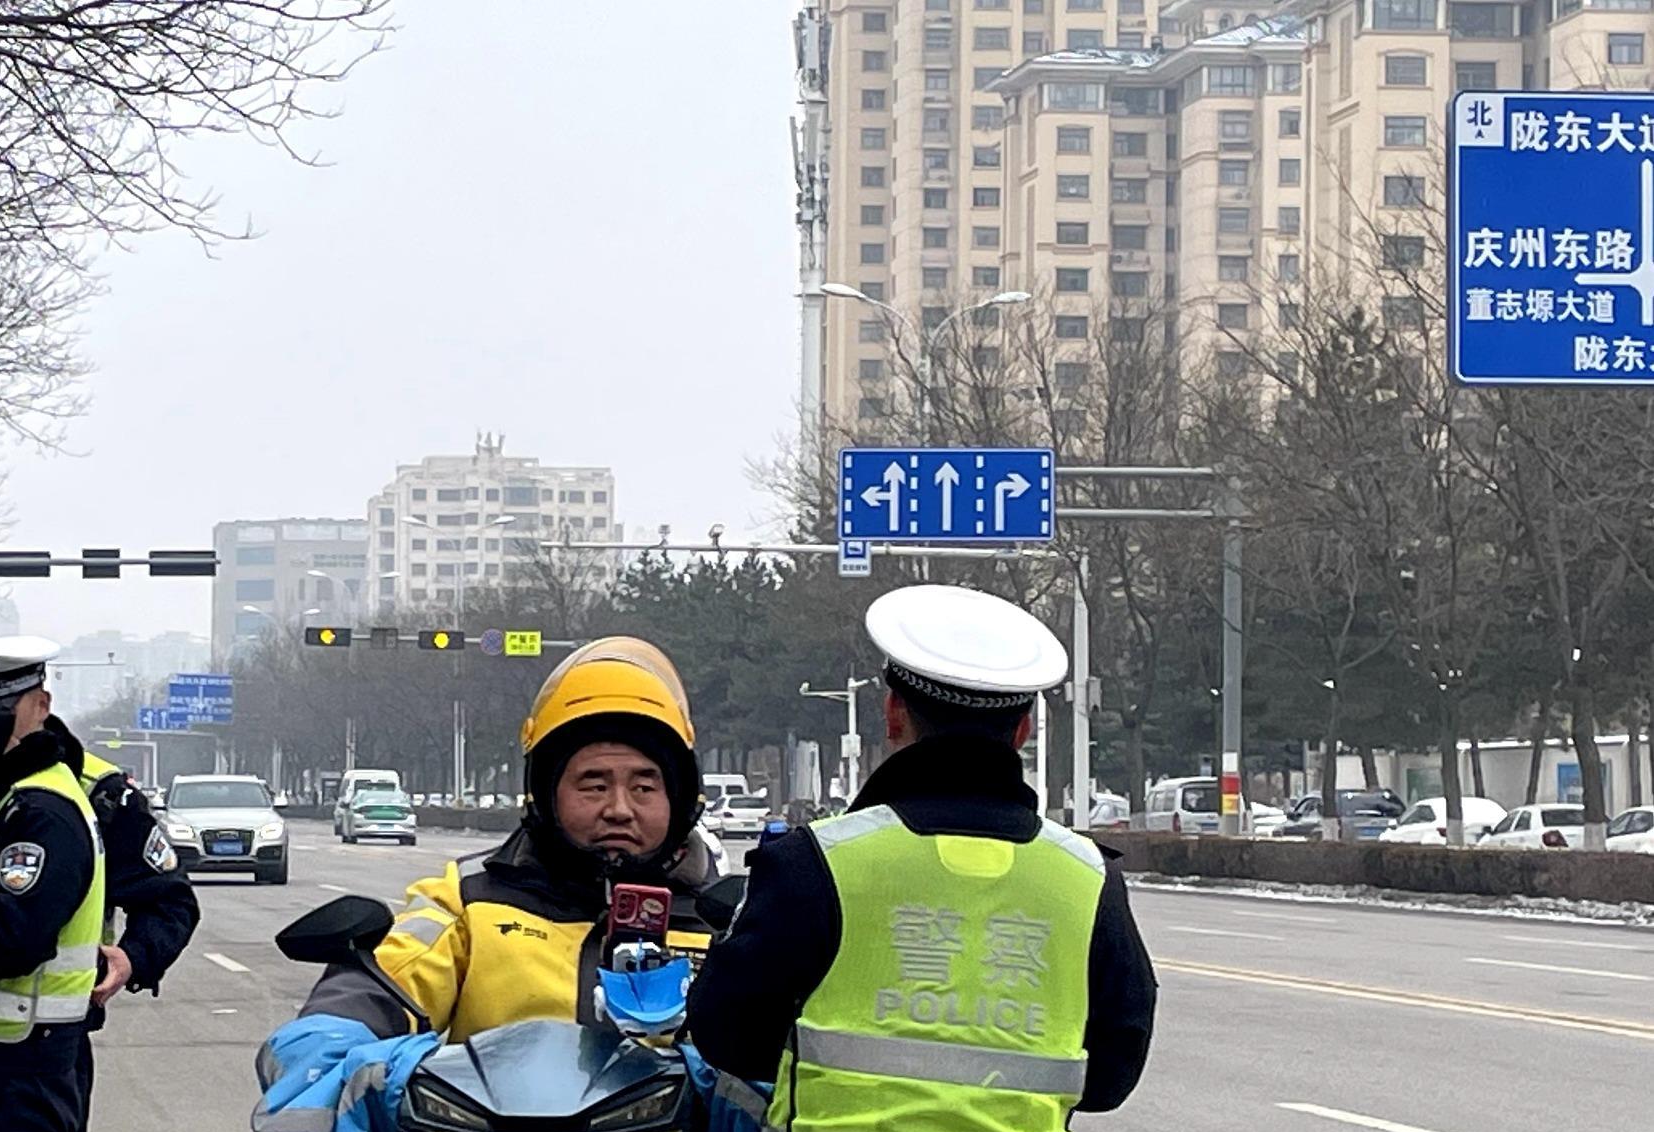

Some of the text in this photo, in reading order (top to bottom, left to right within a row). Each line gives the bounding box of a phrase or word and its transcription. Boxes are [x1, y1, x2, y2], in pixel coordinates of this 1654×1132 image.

[1467, 100, 1493, 128] 北
[1463, 227, 1636, 270] 庆州东路
[1466, 288, 1616, 324] 董志塬大道
[1573, 335, 1654, 372] 陇东
[890, 902, 1052, 989] 警察
[874, 987, 1046, 1037] POLICE
